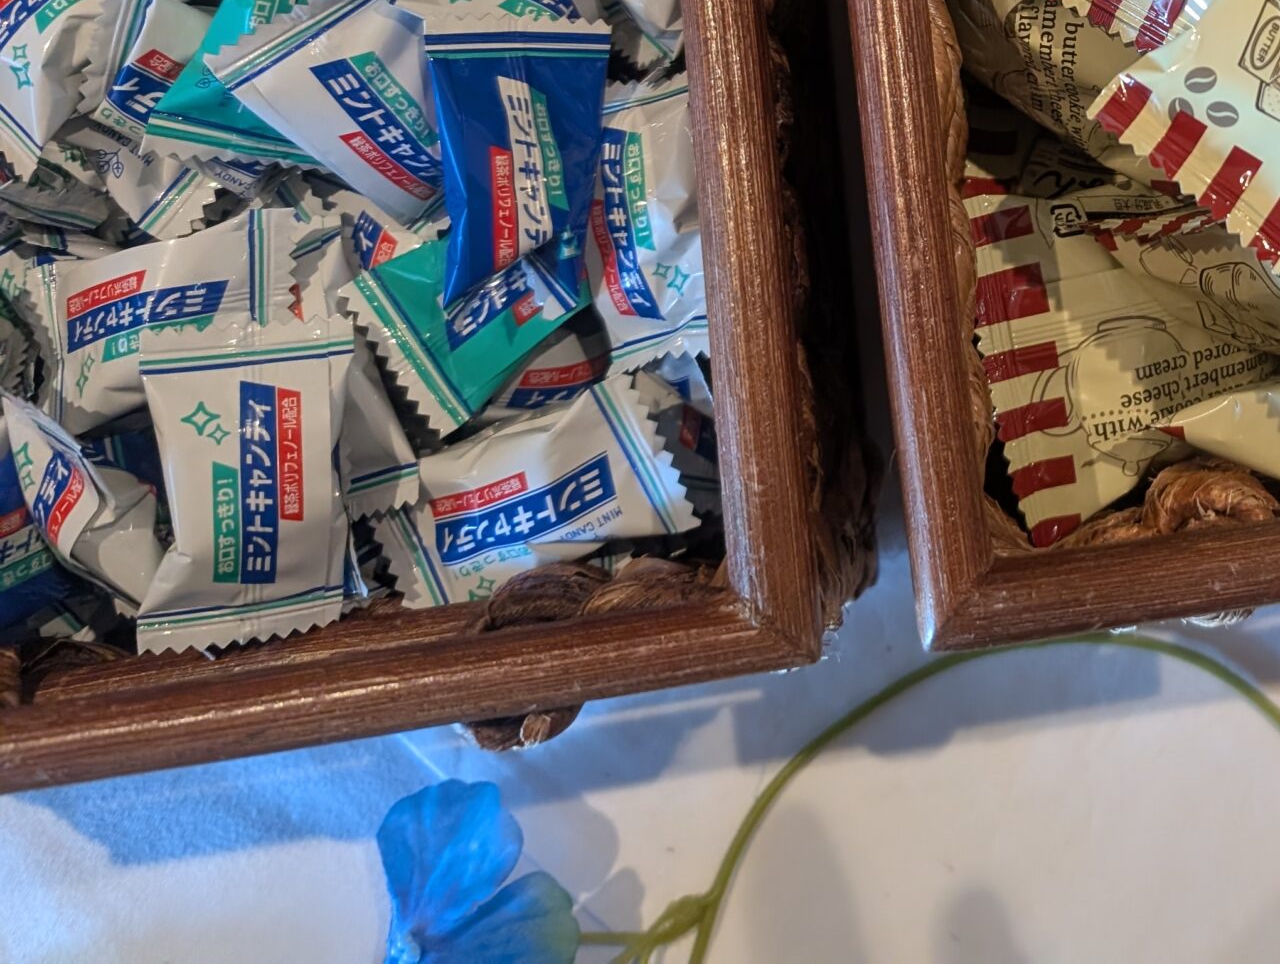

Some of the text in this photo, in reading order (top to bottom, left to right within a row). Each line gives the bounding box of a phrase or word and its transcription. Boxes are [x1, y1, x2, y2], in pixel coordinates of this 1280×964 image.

[1062, 21, 1085, 80] butter
[1120, 382, 1181, 409] cheese
[1135, 354, 1189, 381] cream
[283, 395, 301, 516] 緑茶ポリフェノール配合
[1093, 414, 1144, 442] with
[245, 398, 275, 574] ミントキャンディ
[442, 467, 604, 554] ミントキャンディ
[217, 477, 237, 575] お口すっきり!
[596, 506, 623, 529] MINT
